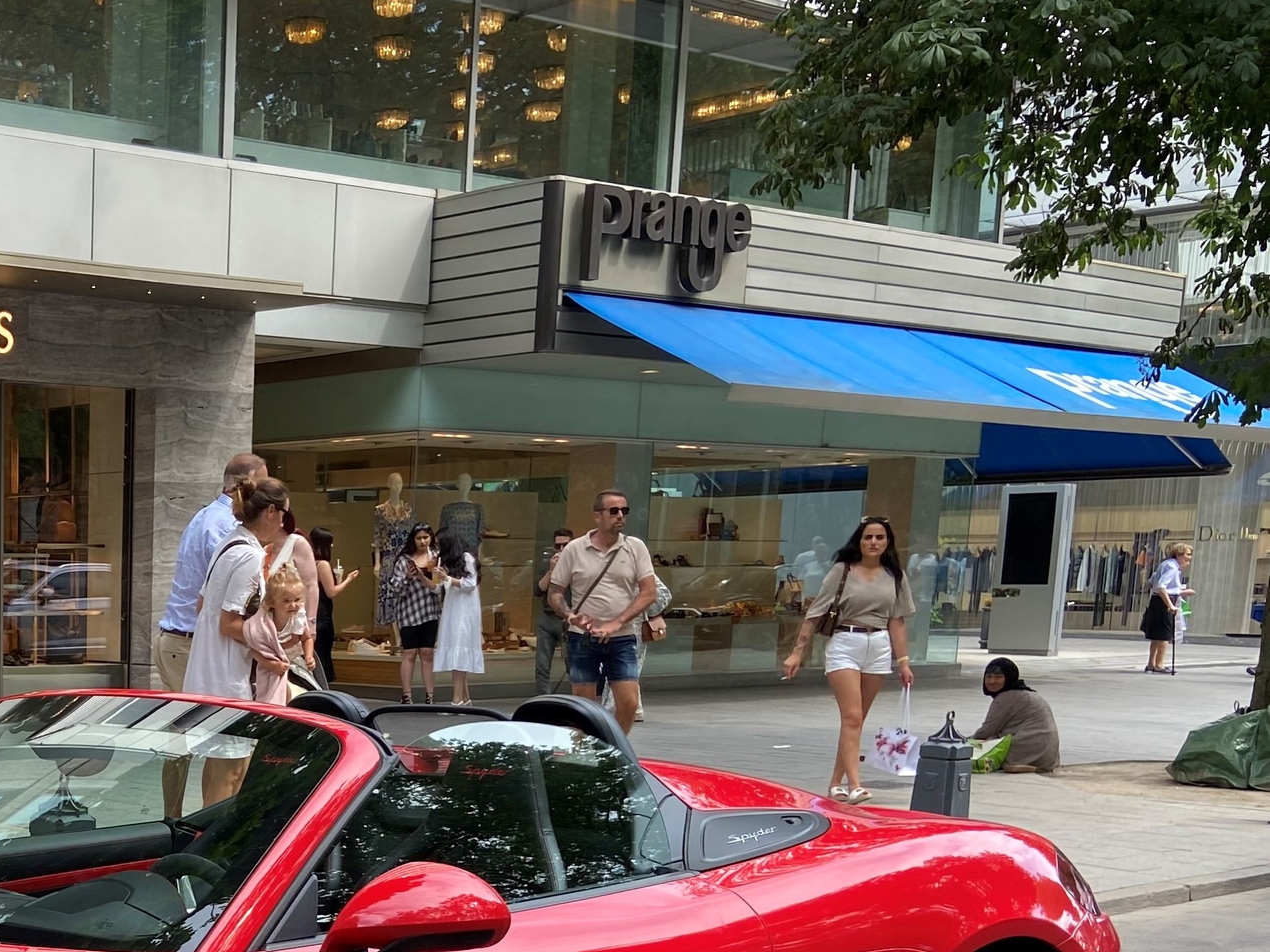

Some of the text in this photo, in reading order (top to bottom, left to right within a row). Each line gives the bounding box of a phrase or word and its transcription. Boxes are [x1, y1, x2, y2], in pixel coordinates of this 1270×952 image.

[580, 183, 752, 293] prange
[1198, 525, 1235, 541] Dior
[727, 826, 777, 844] Spyder
